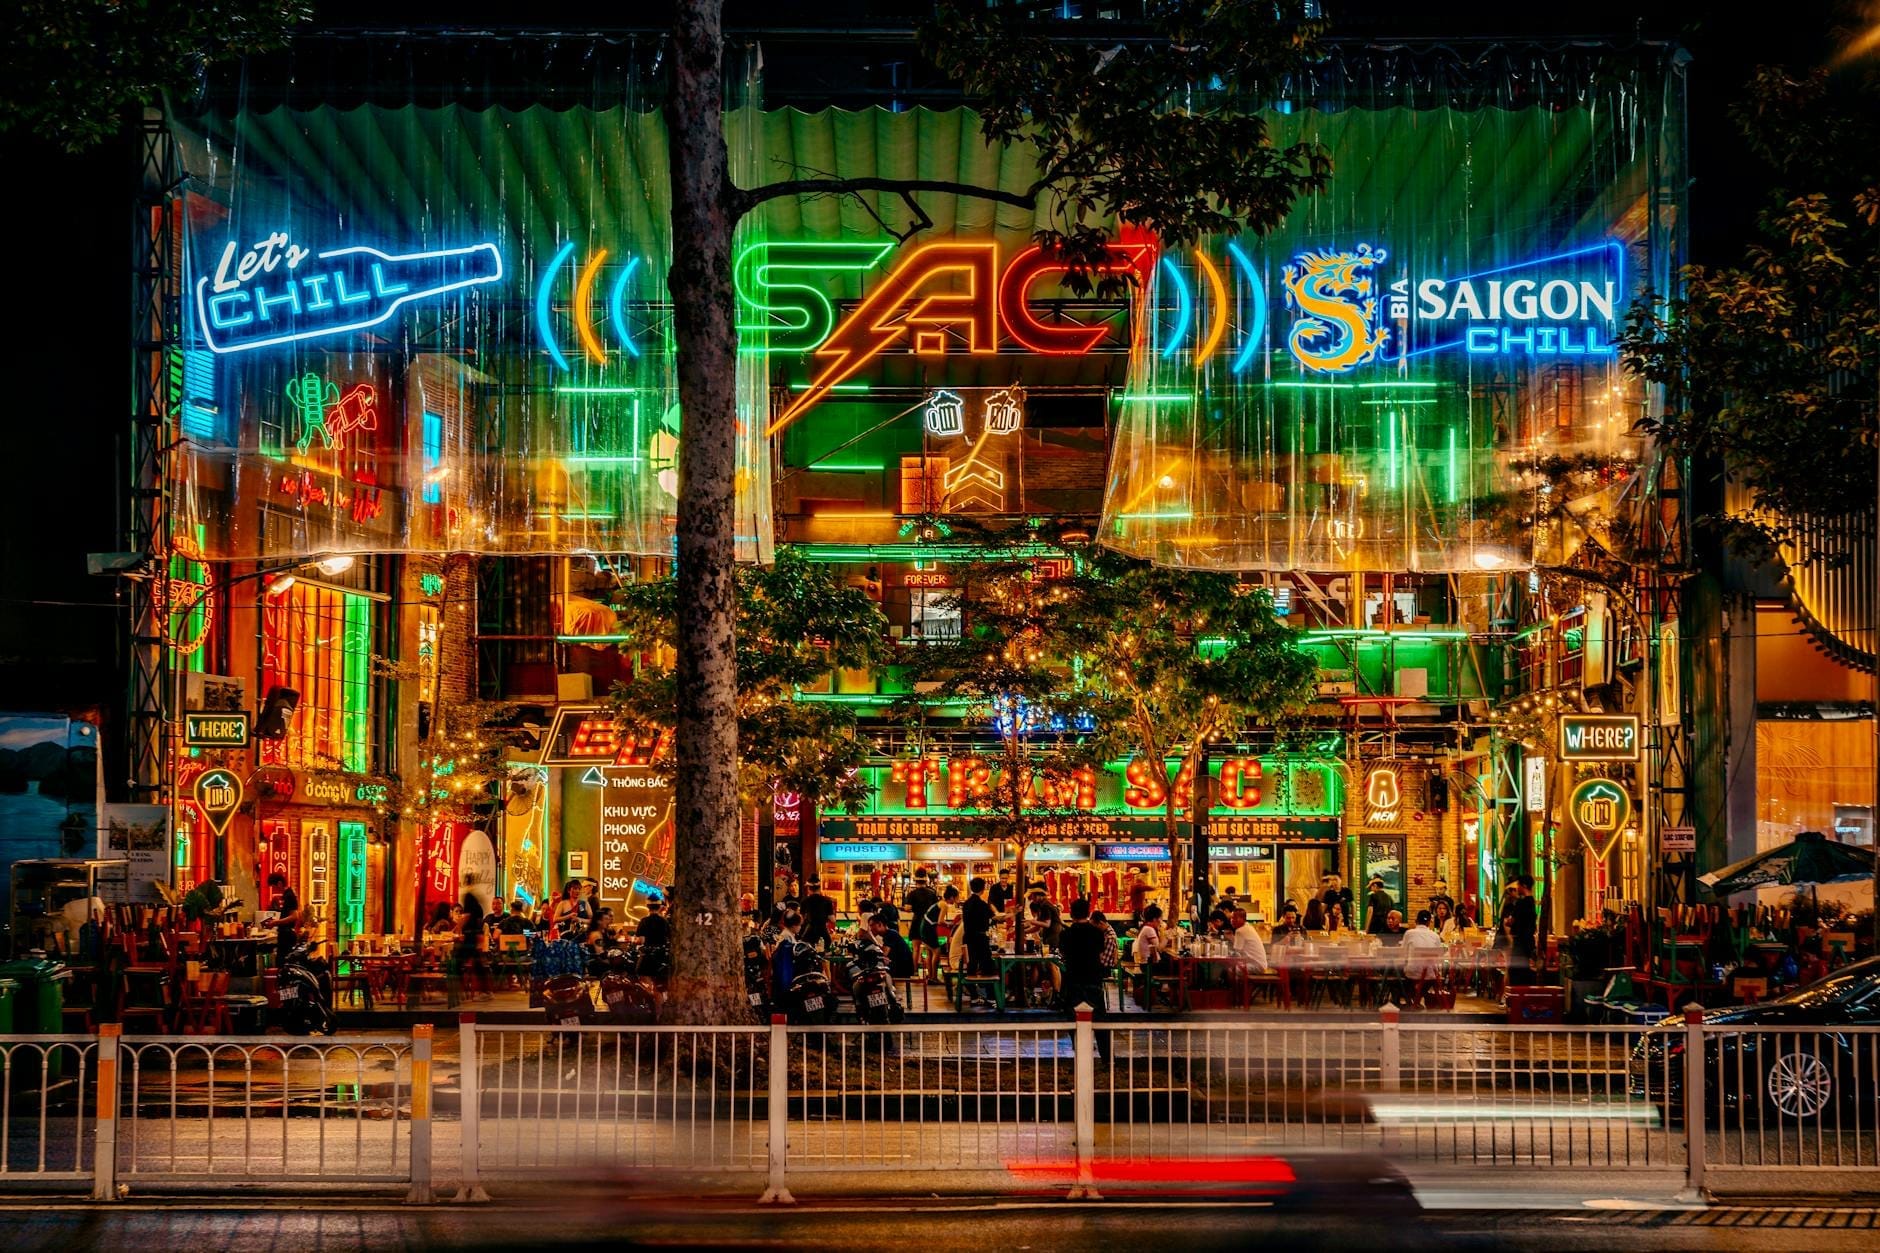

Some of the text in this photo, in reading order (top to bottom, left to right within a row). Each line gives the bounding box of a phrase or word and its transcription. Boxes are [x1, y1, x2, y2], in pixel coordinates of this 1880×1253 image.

[213, 232, 309, 293] Let's
[208, 262, 409, 330] CHILL
[1390, 278, 1409, 320] BIA
[1418, 278, 1615, 321] SAIGON
[1465, 326, 1618, 354] CHILL
[904, 573, 947, 586] FOREVER
[1565, 726, 1634, 749] WHERE?
[611, 775, 646, 788] THÔNG
[603, 805, 657, 820] KHU VỰC
[1369, 811, 1397, 822] MEN
[603, 823, 646, 835] PHONG
[889, 823, 910, 837] SẠC
[911, 823, 939, 836] BEER
[1252, 823, 1280, 836] BEER
[603, 877, 629, 891] SẠC
[695, 912, 713, 926] 42
